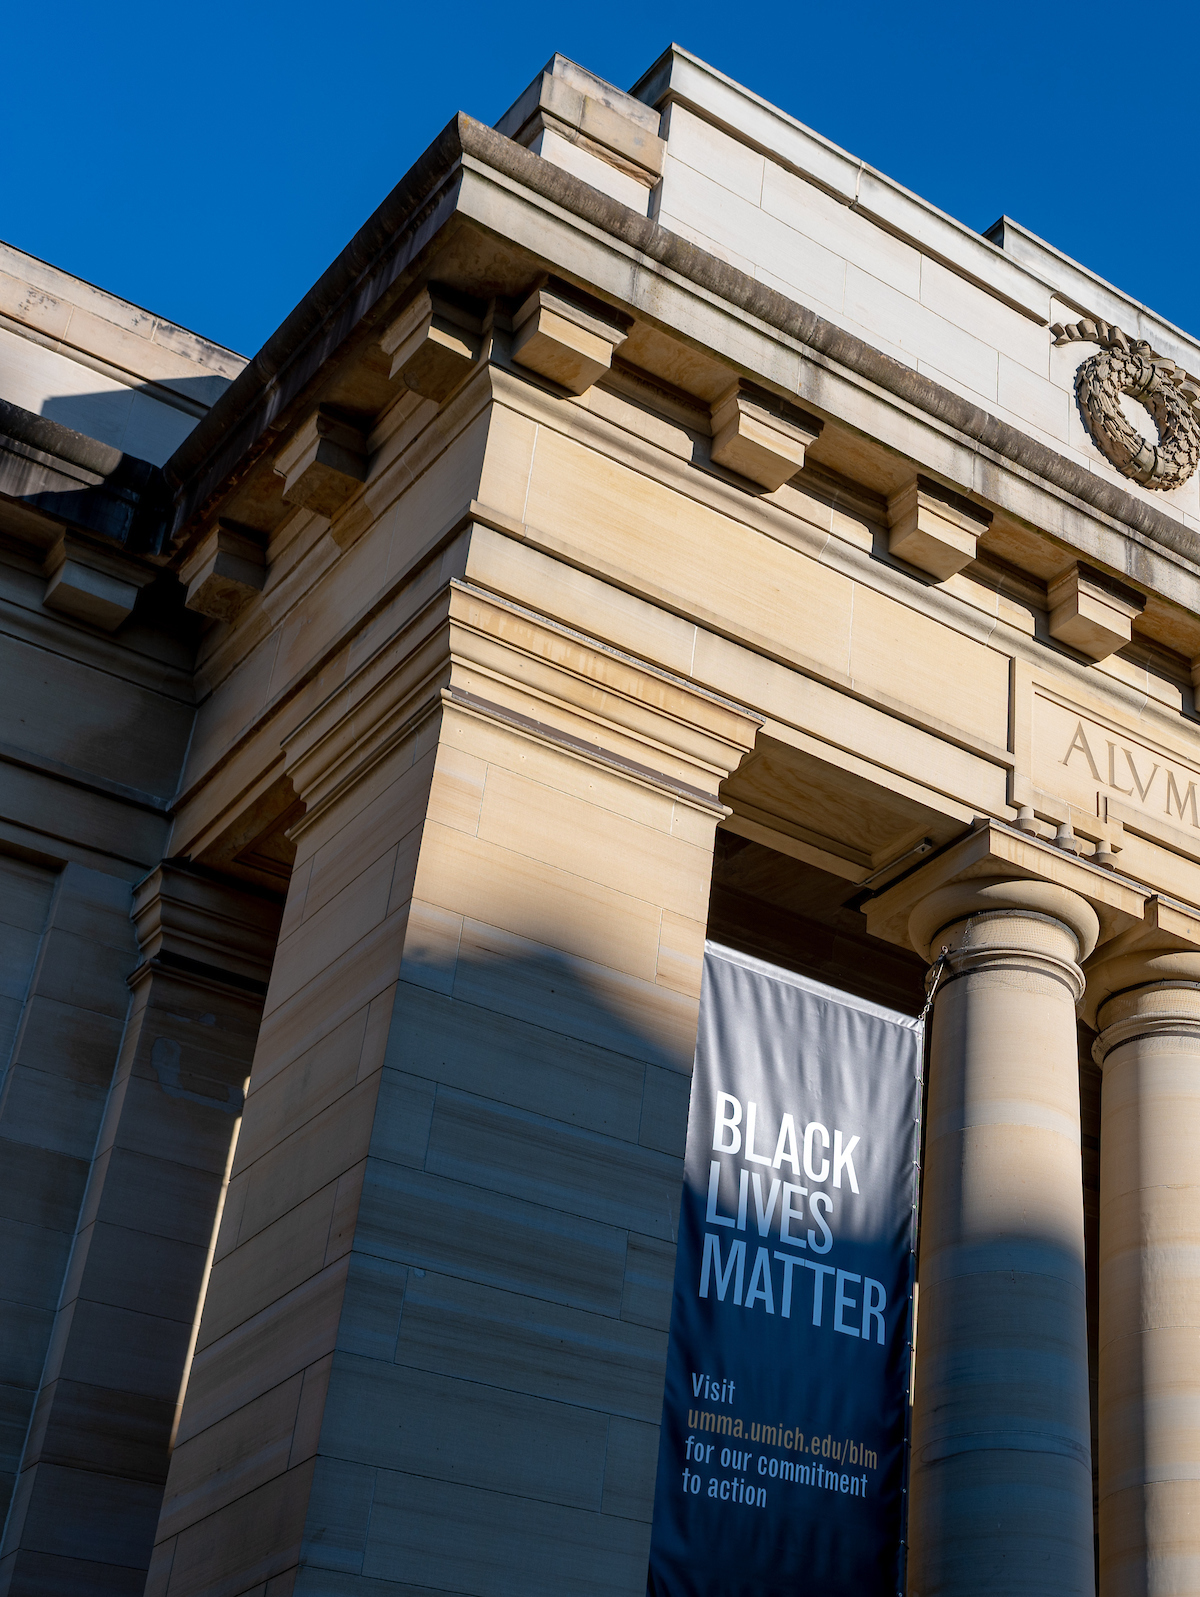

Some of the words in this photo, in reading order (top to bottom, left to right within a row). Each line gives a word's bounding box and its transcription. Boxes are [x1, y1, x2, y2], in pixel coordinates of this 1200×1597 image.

[712, 1090, 860, 1194] BLACK
[705, 1160, 833, 1254] LIVES
[699, 1232, 887, 1345] MATTER
[692, 1372, 735, 1405] Visit
[685, 1435, 715, 1464] for
[720, 1447, 752, 1472] our
[757, 1455, 868, 1498] commitment
[687, 1408, 878, 1470] umma.umich.edu/blm
[682, 1467, 701, 1495] to
[707, 1476, 767, 1508] action
